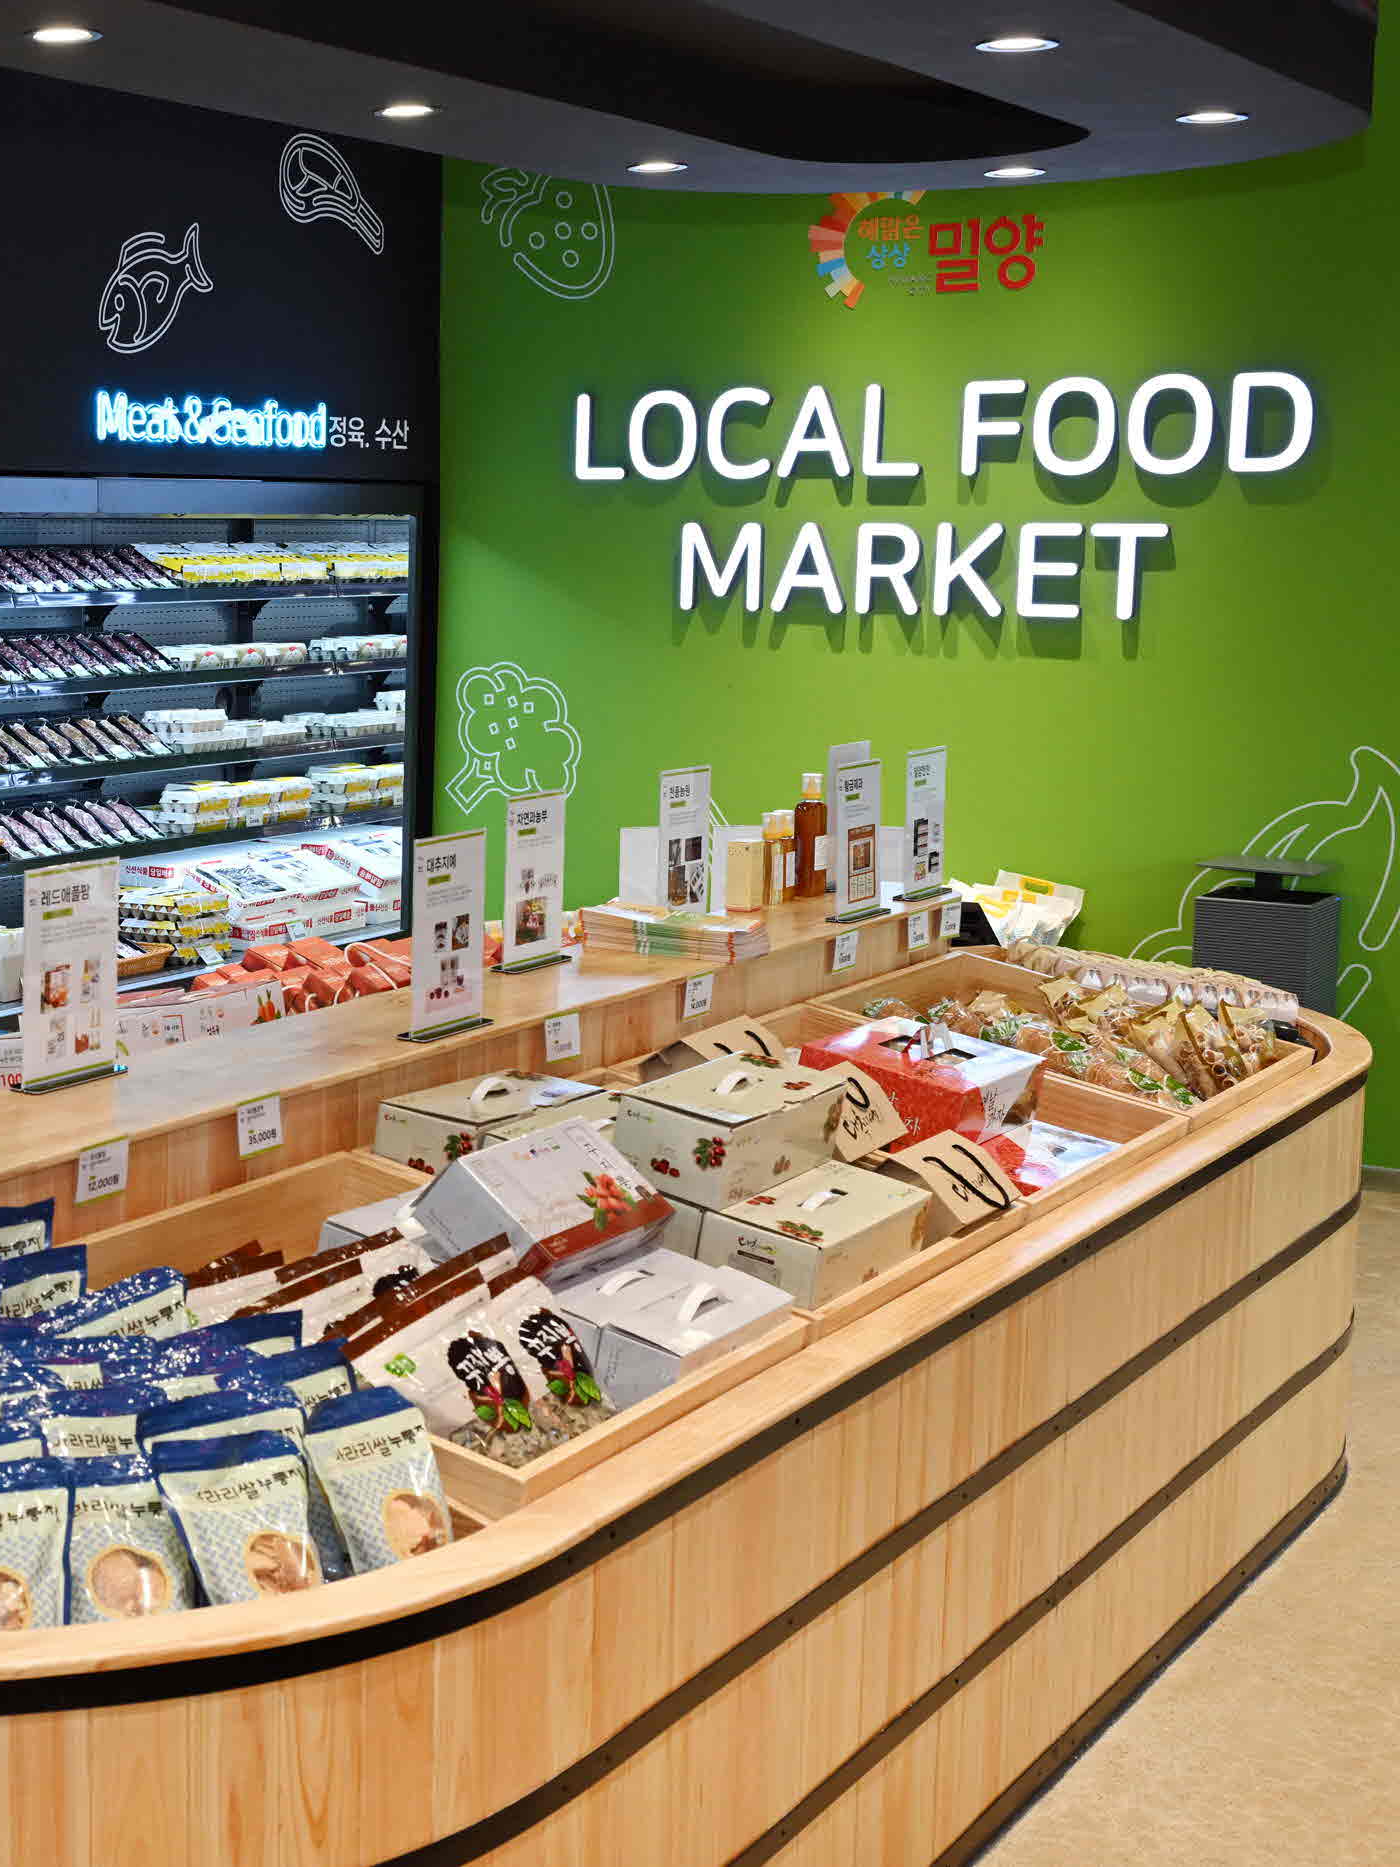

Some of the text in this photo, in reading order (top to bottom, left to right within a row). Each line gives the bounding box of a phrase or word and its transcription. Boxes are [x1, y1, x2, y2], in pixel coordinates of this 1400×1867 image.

[866, 242, 911, 270] 상상
[928, 213, 1046, 293] 밀양
[96, 391, 179, 443] Meat
[329, 415, 410, 450] 정육. 수산
[574, 372, 1315, 480] LOCAL FOOD
[679, 521, 1169, 621] MARKET
[248, 1128, 277, 1145] 35,000원
